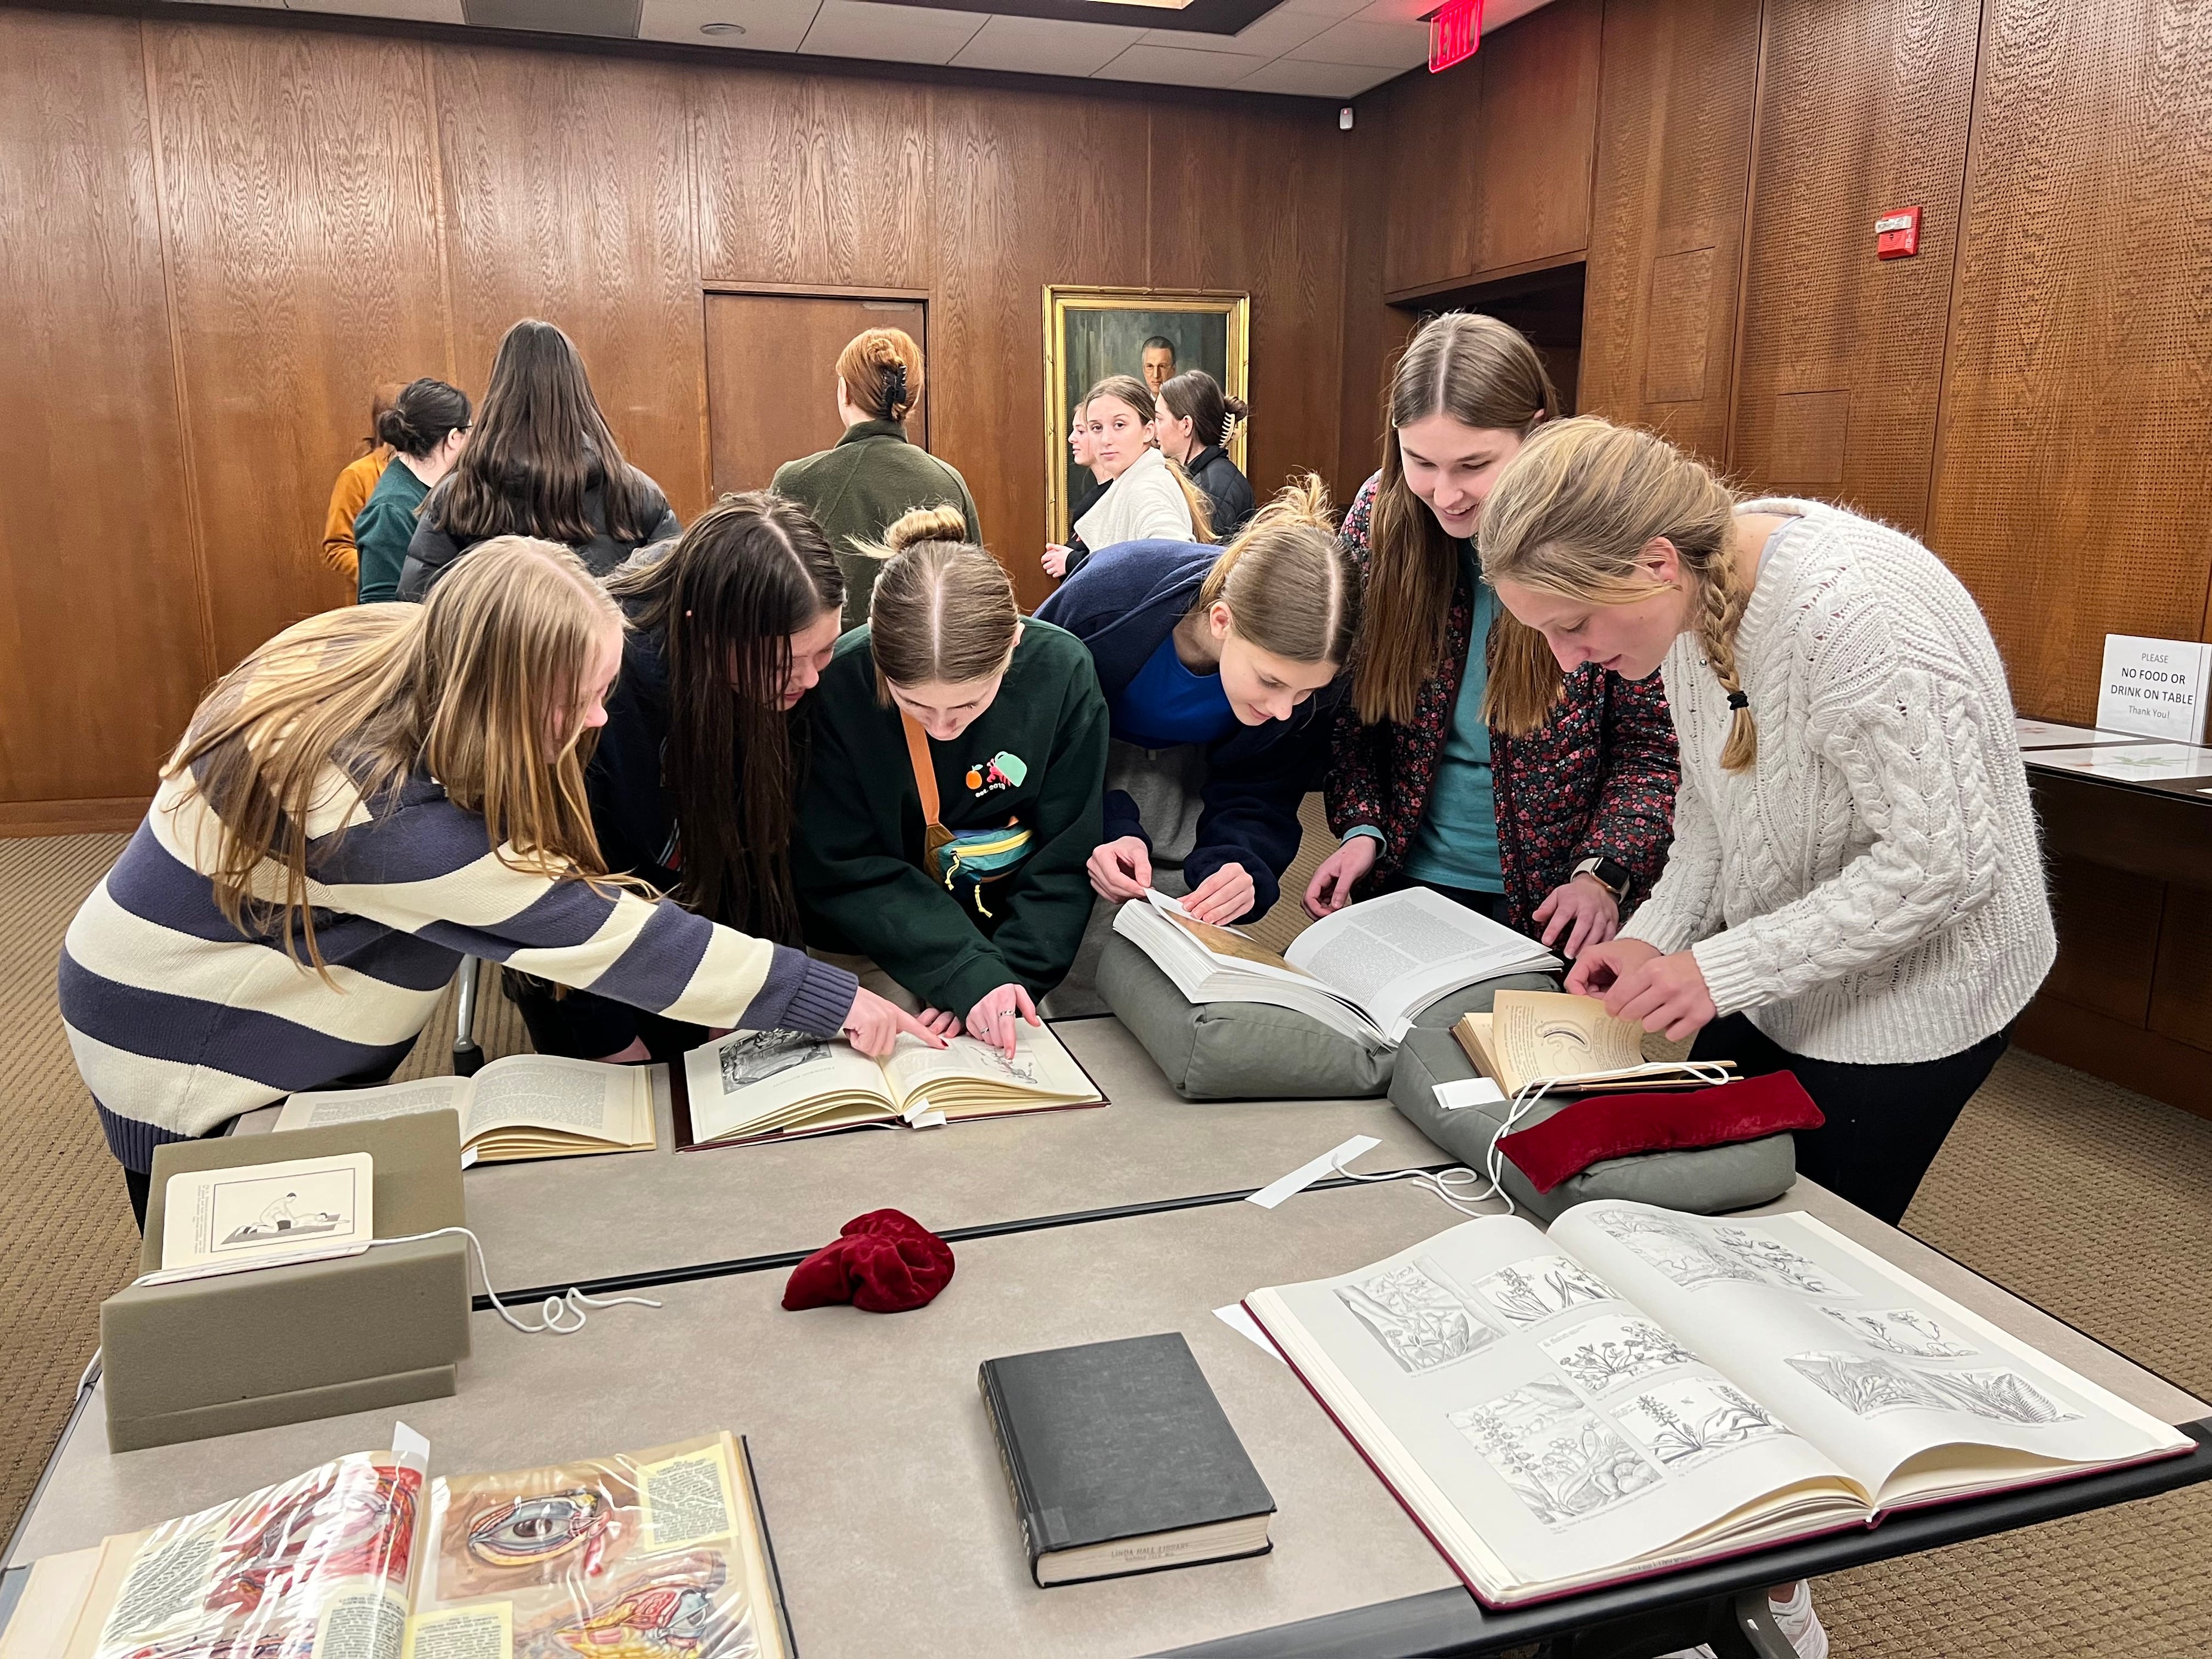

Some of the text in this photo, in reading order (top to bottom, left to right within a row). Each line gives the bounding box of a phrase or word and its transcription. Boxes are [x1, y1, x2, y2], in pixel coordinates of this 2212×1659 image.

[2142, 653, 2168, 663] PLEASE
[2121, 667, 2186, 685] NO FOOD OR
[2111, 684, 2194, 705] DRINK ON TABLE
[2128, 705, 2170, 719] Thank You!
[975, 789, 988, 797] est.
[1111, 1549, 1133, 1558] LINDA
[1136, 1547, 1156, 1555] HALL
